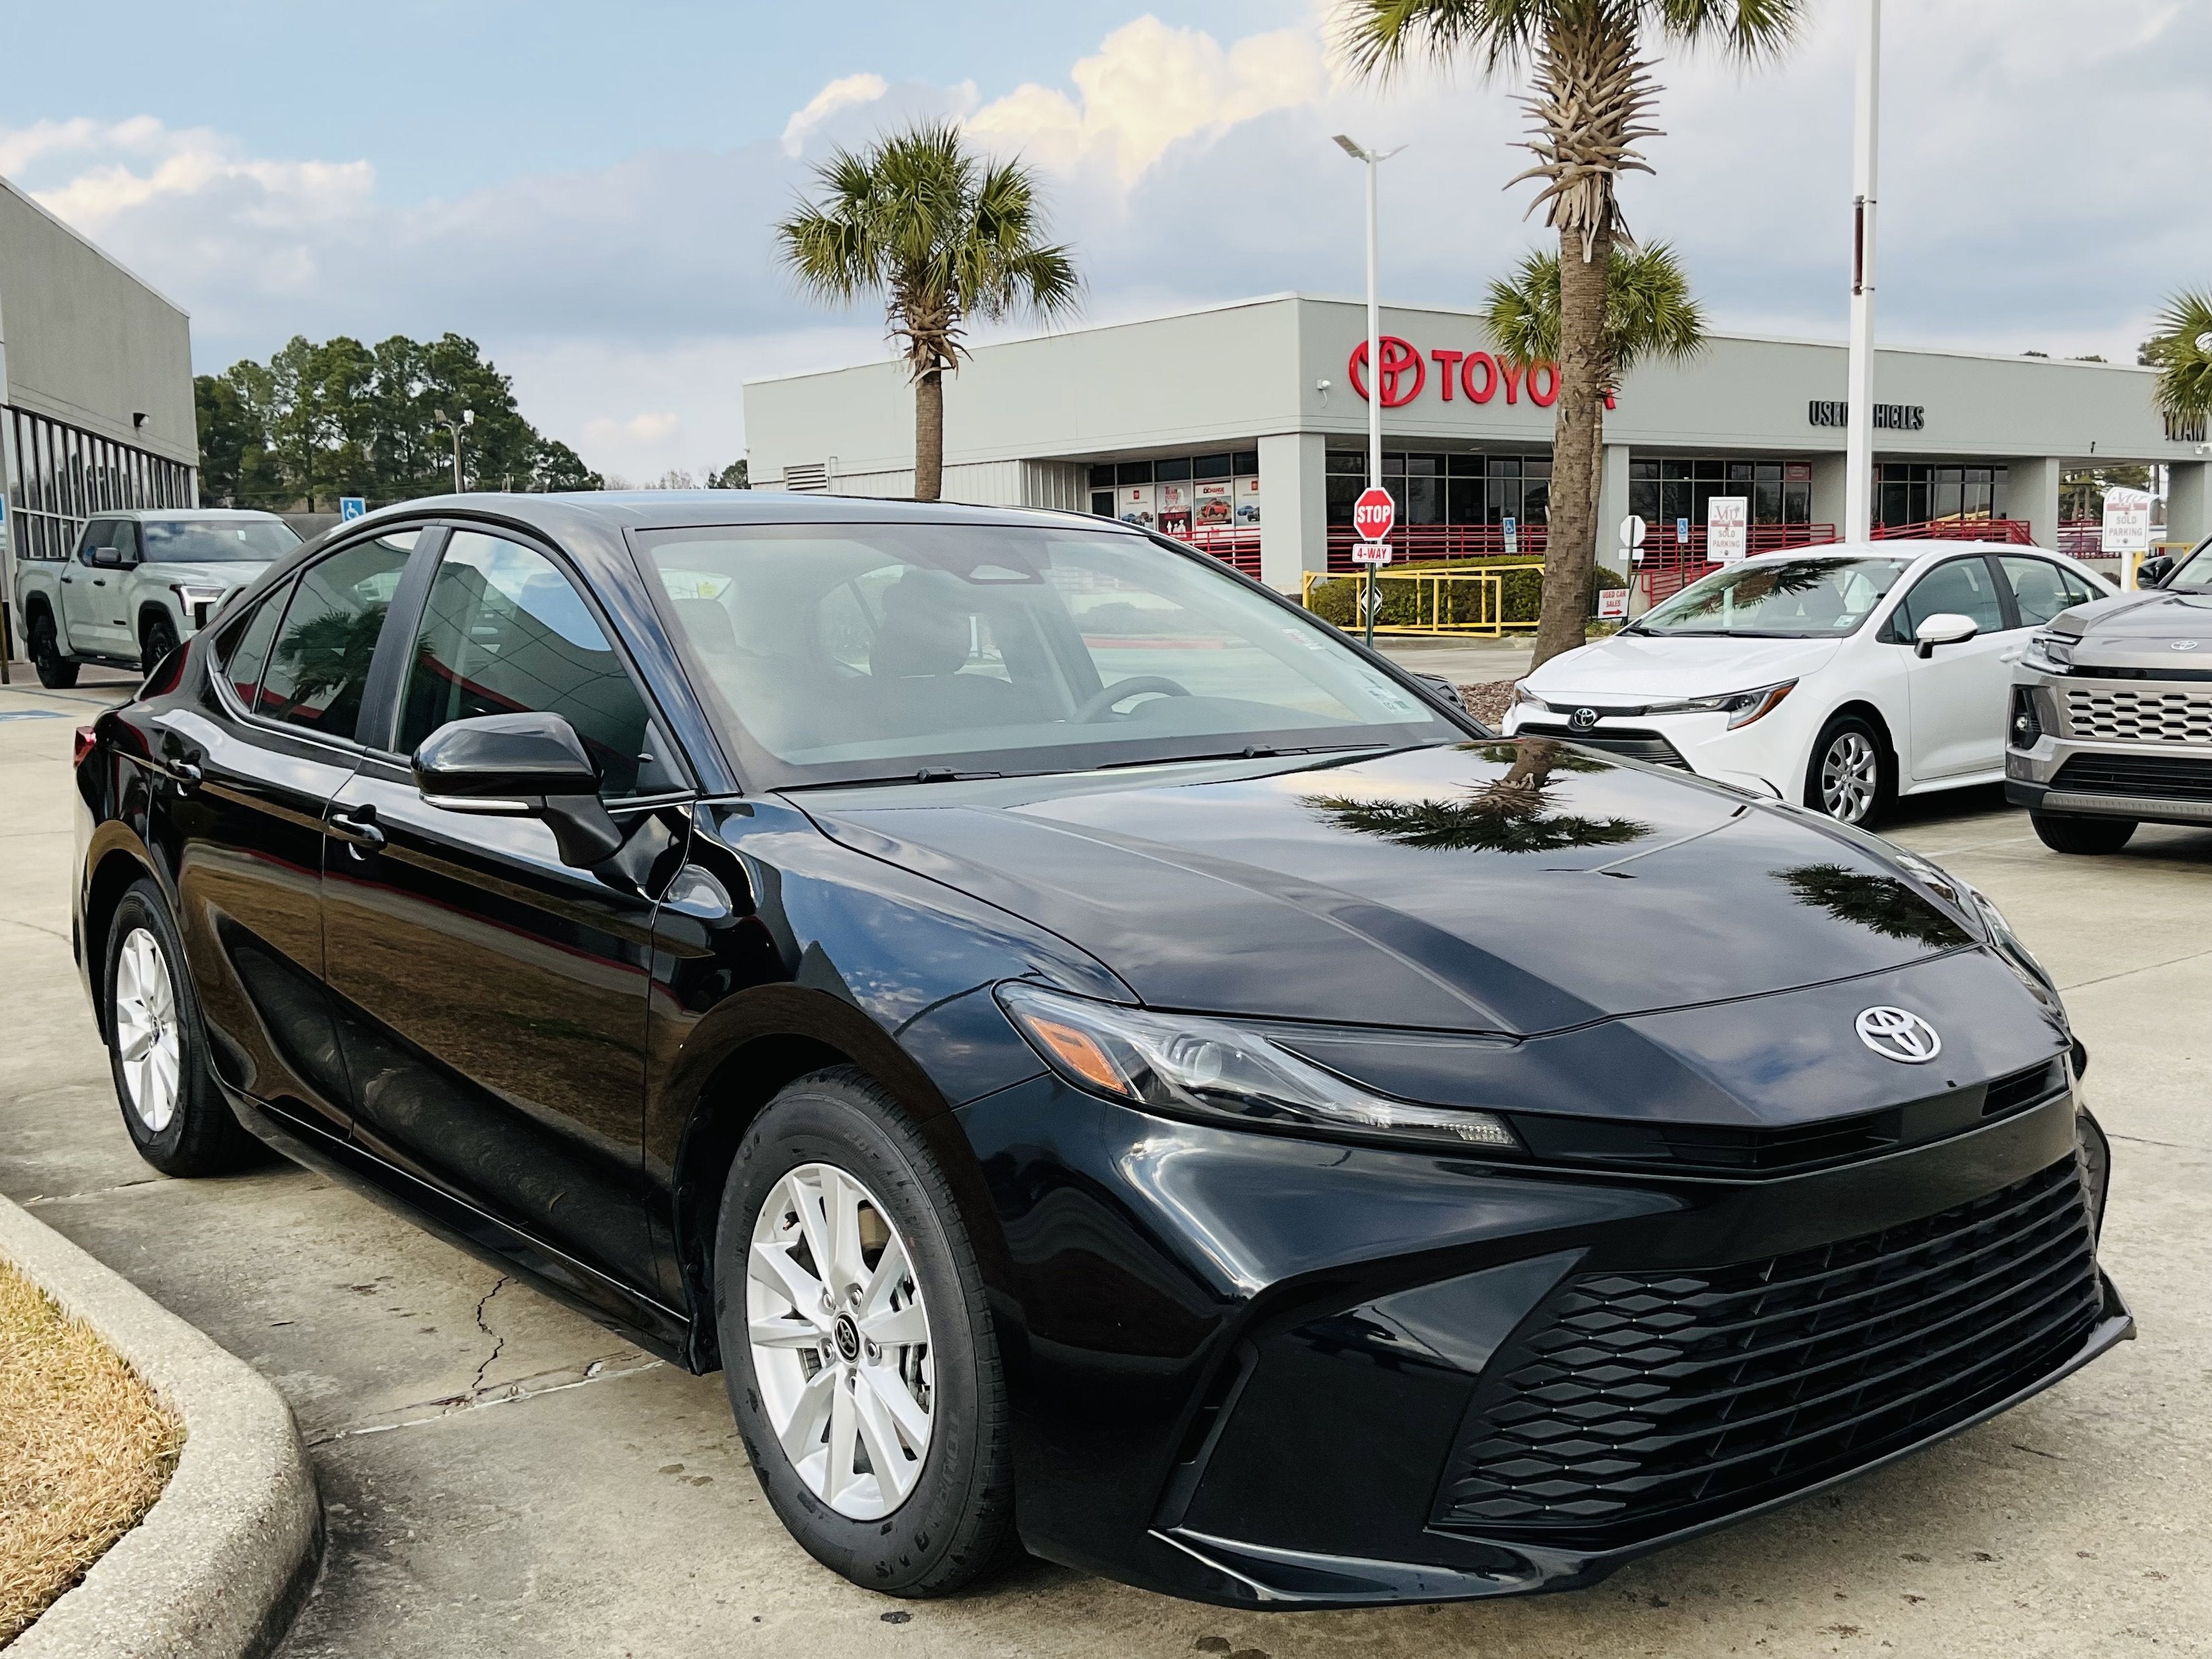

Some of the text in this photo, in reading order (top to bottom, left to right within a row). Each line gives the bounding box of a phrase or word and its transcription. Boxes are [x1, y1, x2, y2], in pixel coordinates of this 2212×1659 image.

[1431, 350, 1616, 410] TOYO
[1872, 404, 1924, 430] HICLES
[1357, 505, 1391, 523] STOP
[2116, 516, 2137, 524] SOLD
[2109, 527, 2143, 536] PARKING
[1713, 540, 1740, 548] PARKING
[1357, 547, 1387, 560] 4-WAY
[1606, 599, 1621, 607] SALES
